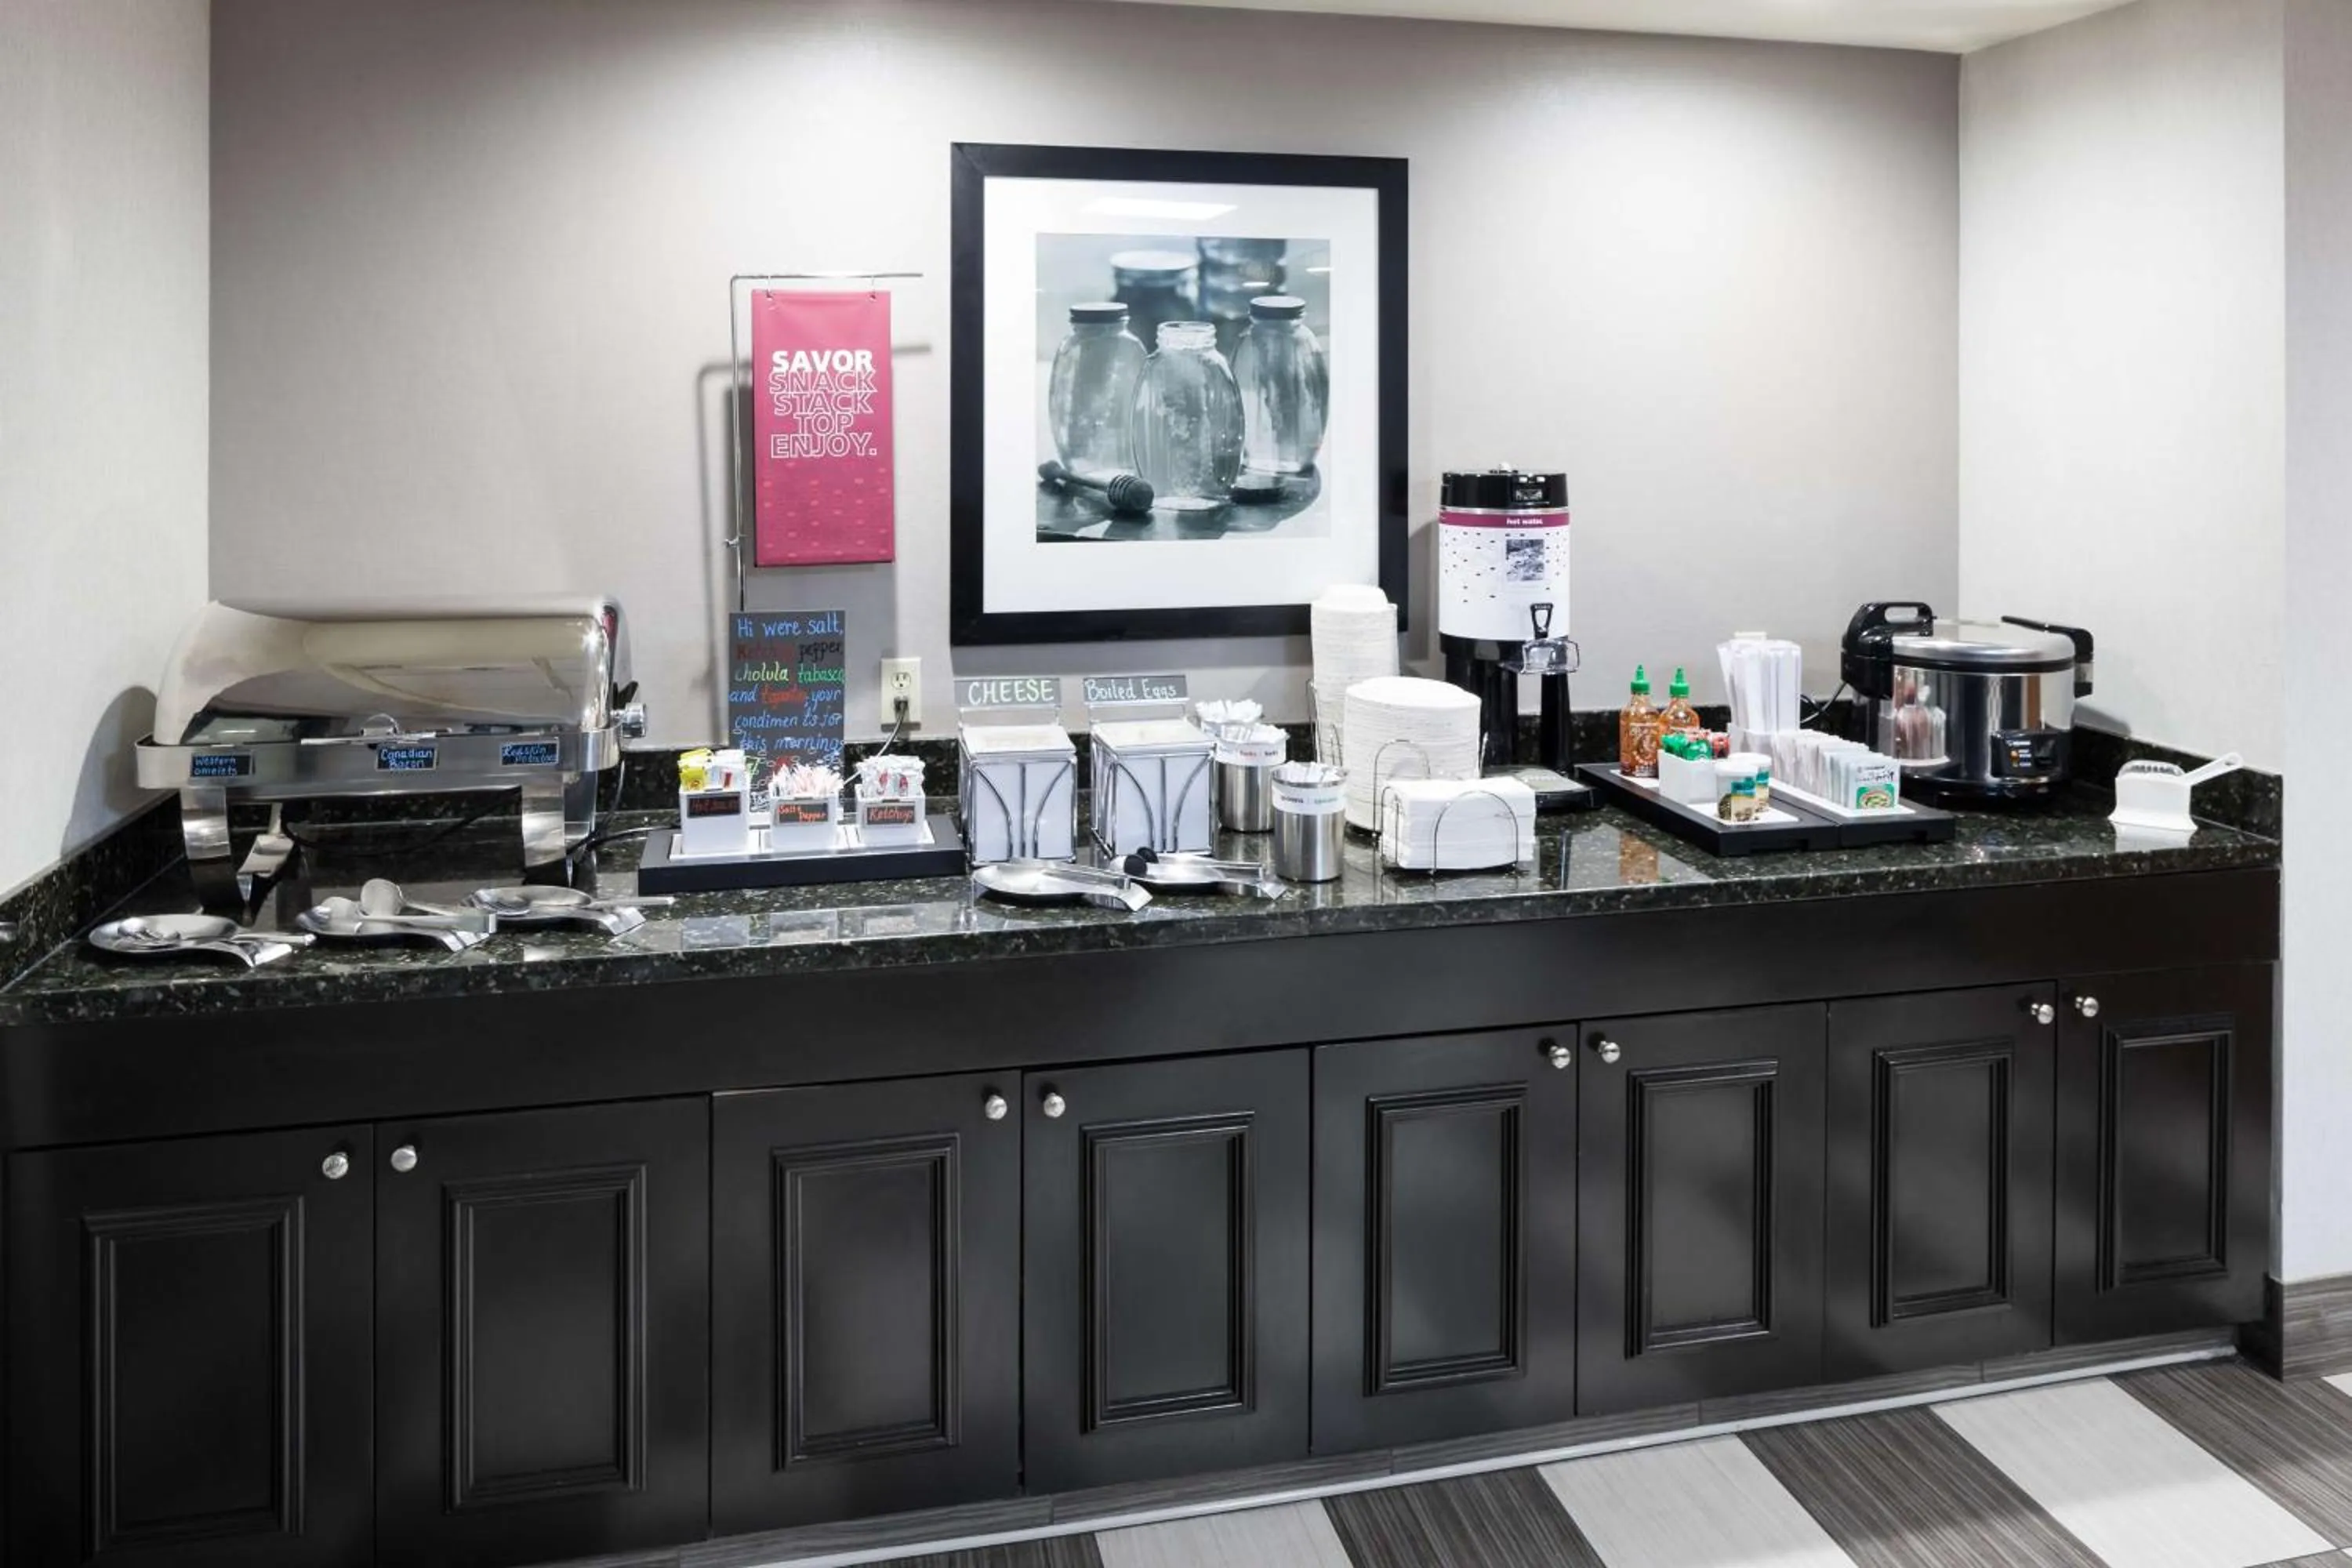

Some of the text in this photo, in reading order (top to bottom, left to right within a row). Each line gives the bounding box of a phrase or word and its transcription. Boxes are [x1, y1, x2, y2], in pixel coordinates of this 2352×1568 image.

[771, 350, 876, 374] SAVOR
[768, 370, 877, 394] SNACK
[774, 392, 873, 416] STACK
[793, 412, 854, 436] TOP
[771, 432, 877, 459] ENJOY.
[737, 618, 753, 637] Hi
[735, 662, 789, 682] cholula
[729, 684, 759, 702] and
[968, 679, 1054, 705] CHEESE
[1084, 678, 1137, 701] Boiled
